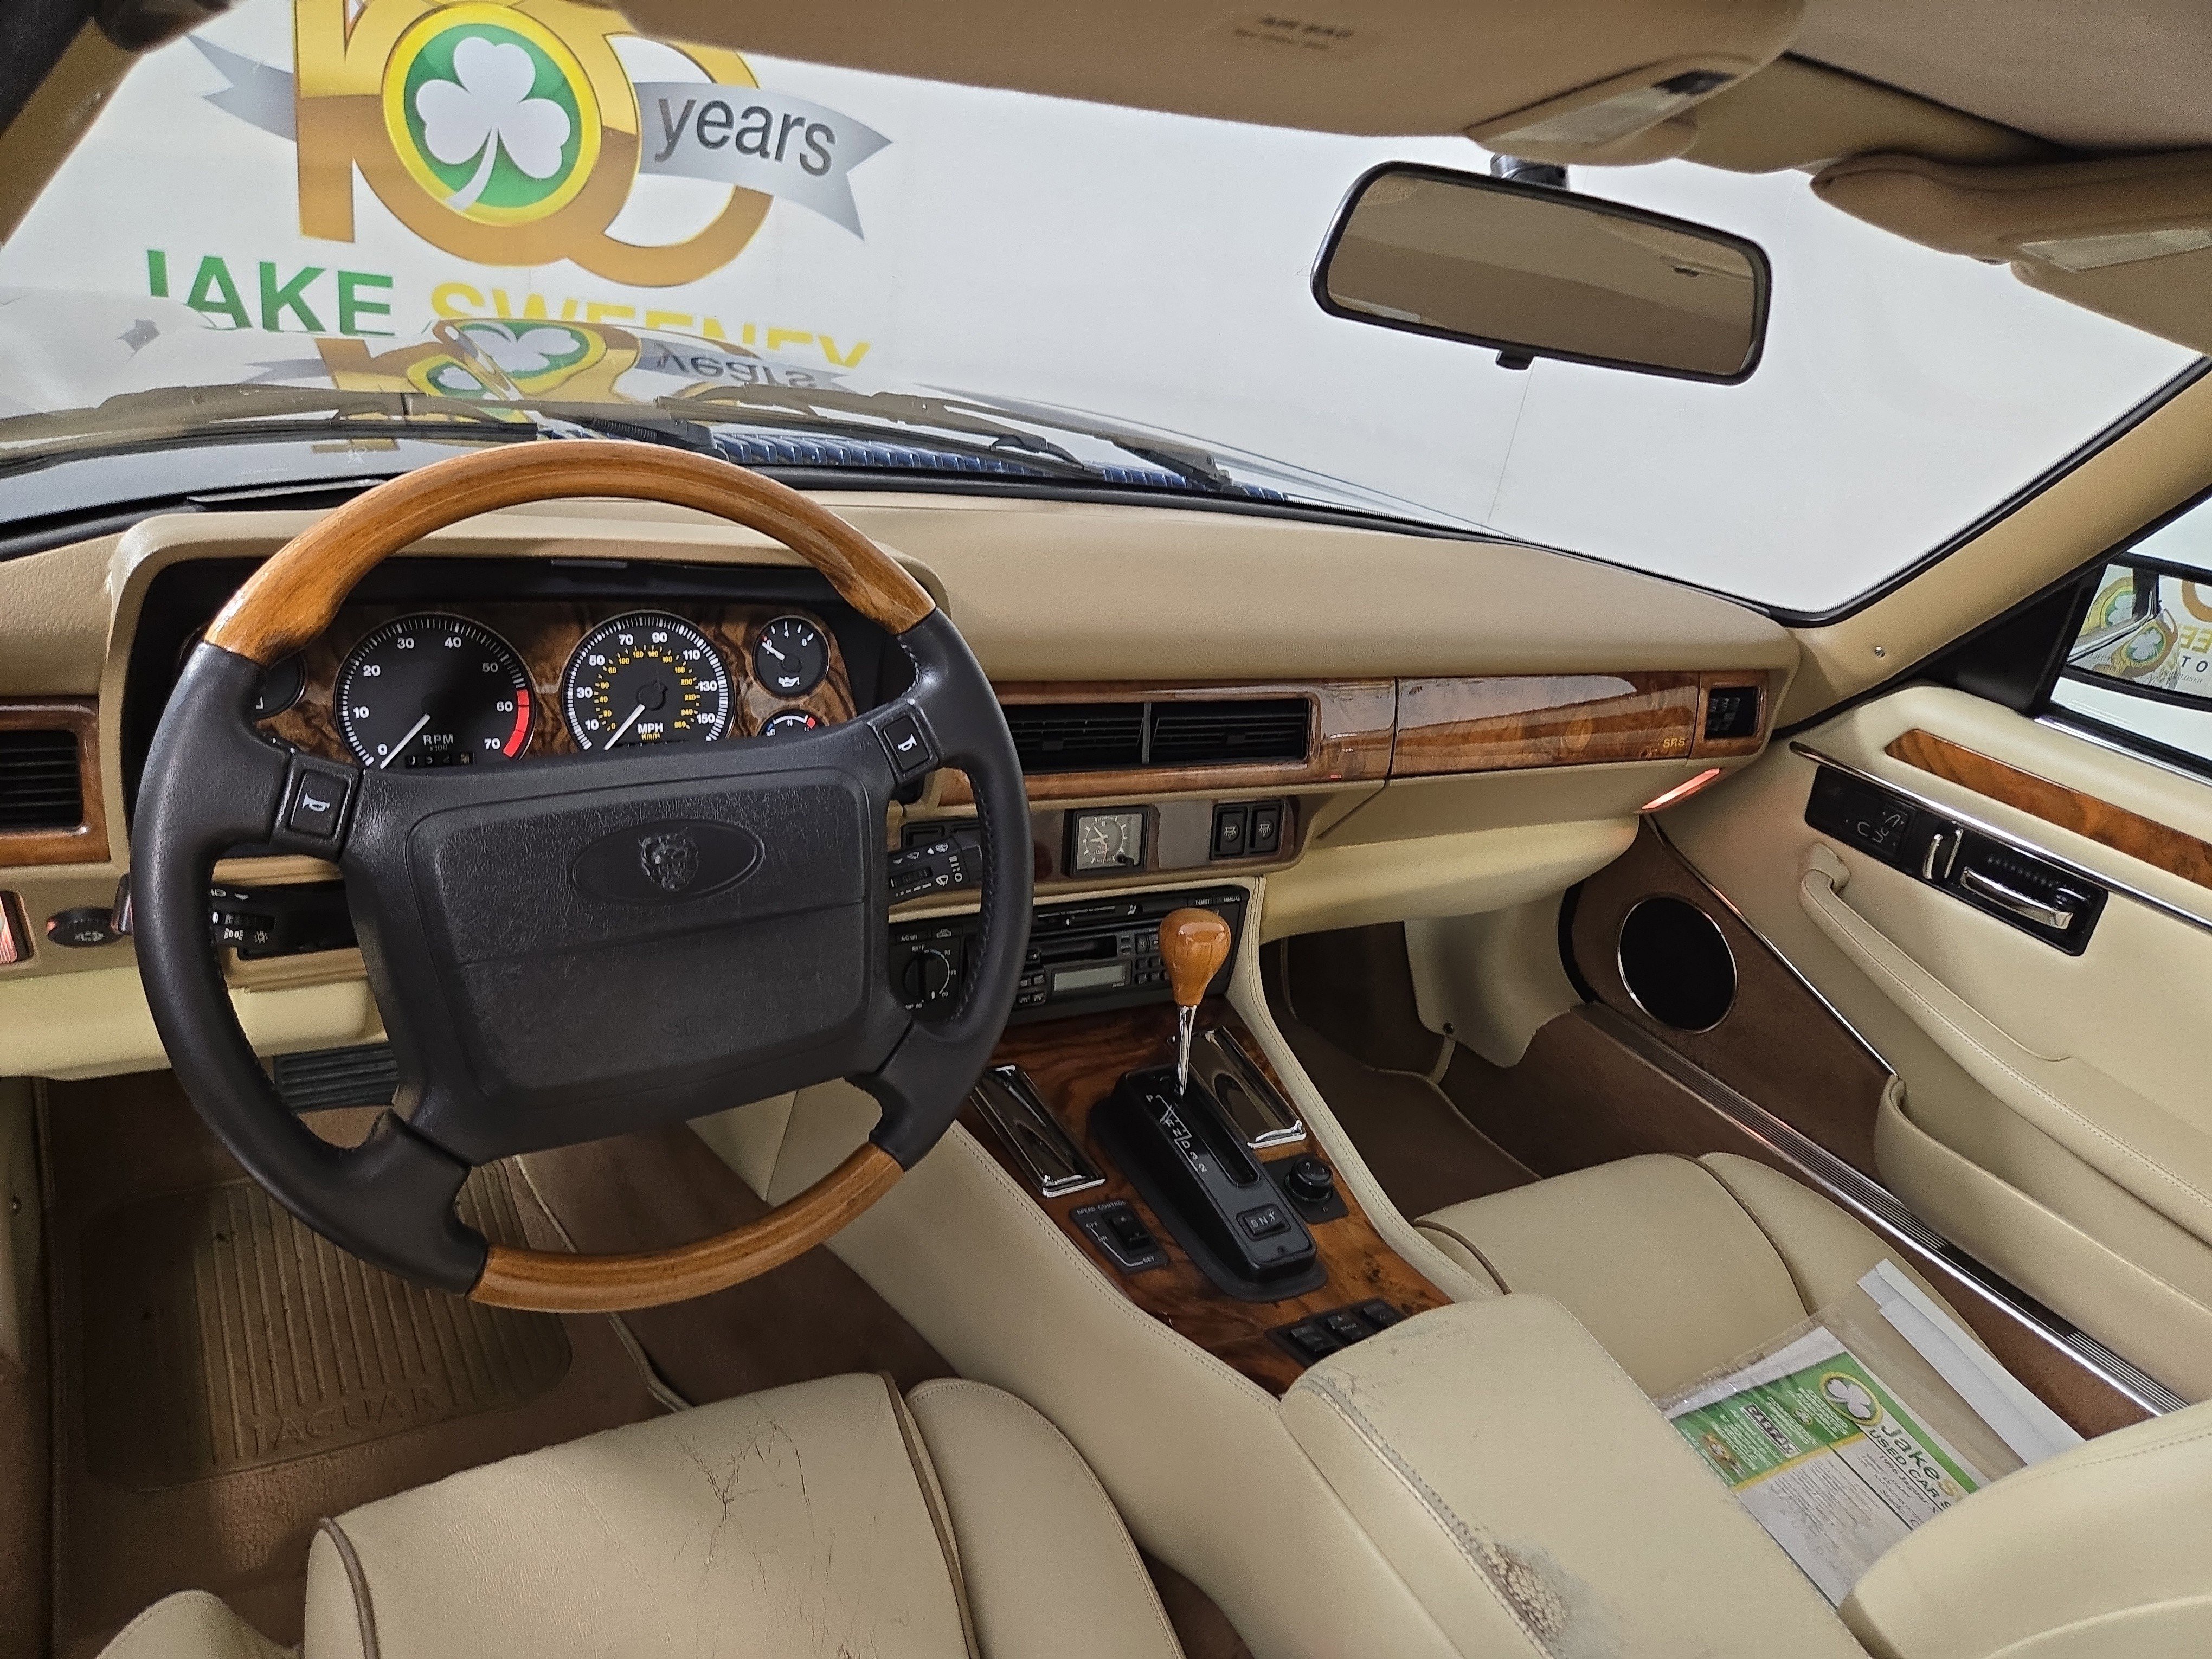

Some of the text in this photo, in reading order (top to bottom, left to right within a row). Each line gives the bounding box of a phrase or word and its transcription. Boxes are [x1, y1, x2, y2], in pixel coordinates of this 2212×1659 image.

[654, 95, 837, 177] years
[397, 638, 415, 650] 30
[445, 636, 461, 648] 40
[619, 634, 634, 645] 70
[683, 650, 700, 661] 110
[363, 665, 381, 677] 20
[698, 680, 718, 692] 130
[576, 687, 593, 699] 30
[353, 706, 370, 719] 10
[696, 712, 716, 724] 150
[584, 719, 600, 731] 10
[611, 722, 616, 730] 0
[637, 722, 664, 735] MPH
[423, 734, 454, 746] RPM
[484, 738, 501, 750] 70
[1662, 736, 1686, 749] SRS
[377, 743, 388, 756] 0
[1198, 1162, 1207, 1173] 2
[244, 1386, 441, 1458] JAGUAR
[1869, 1429, 1907, 1465] USED
[1908, 1468, 1940, 1498] CAR
